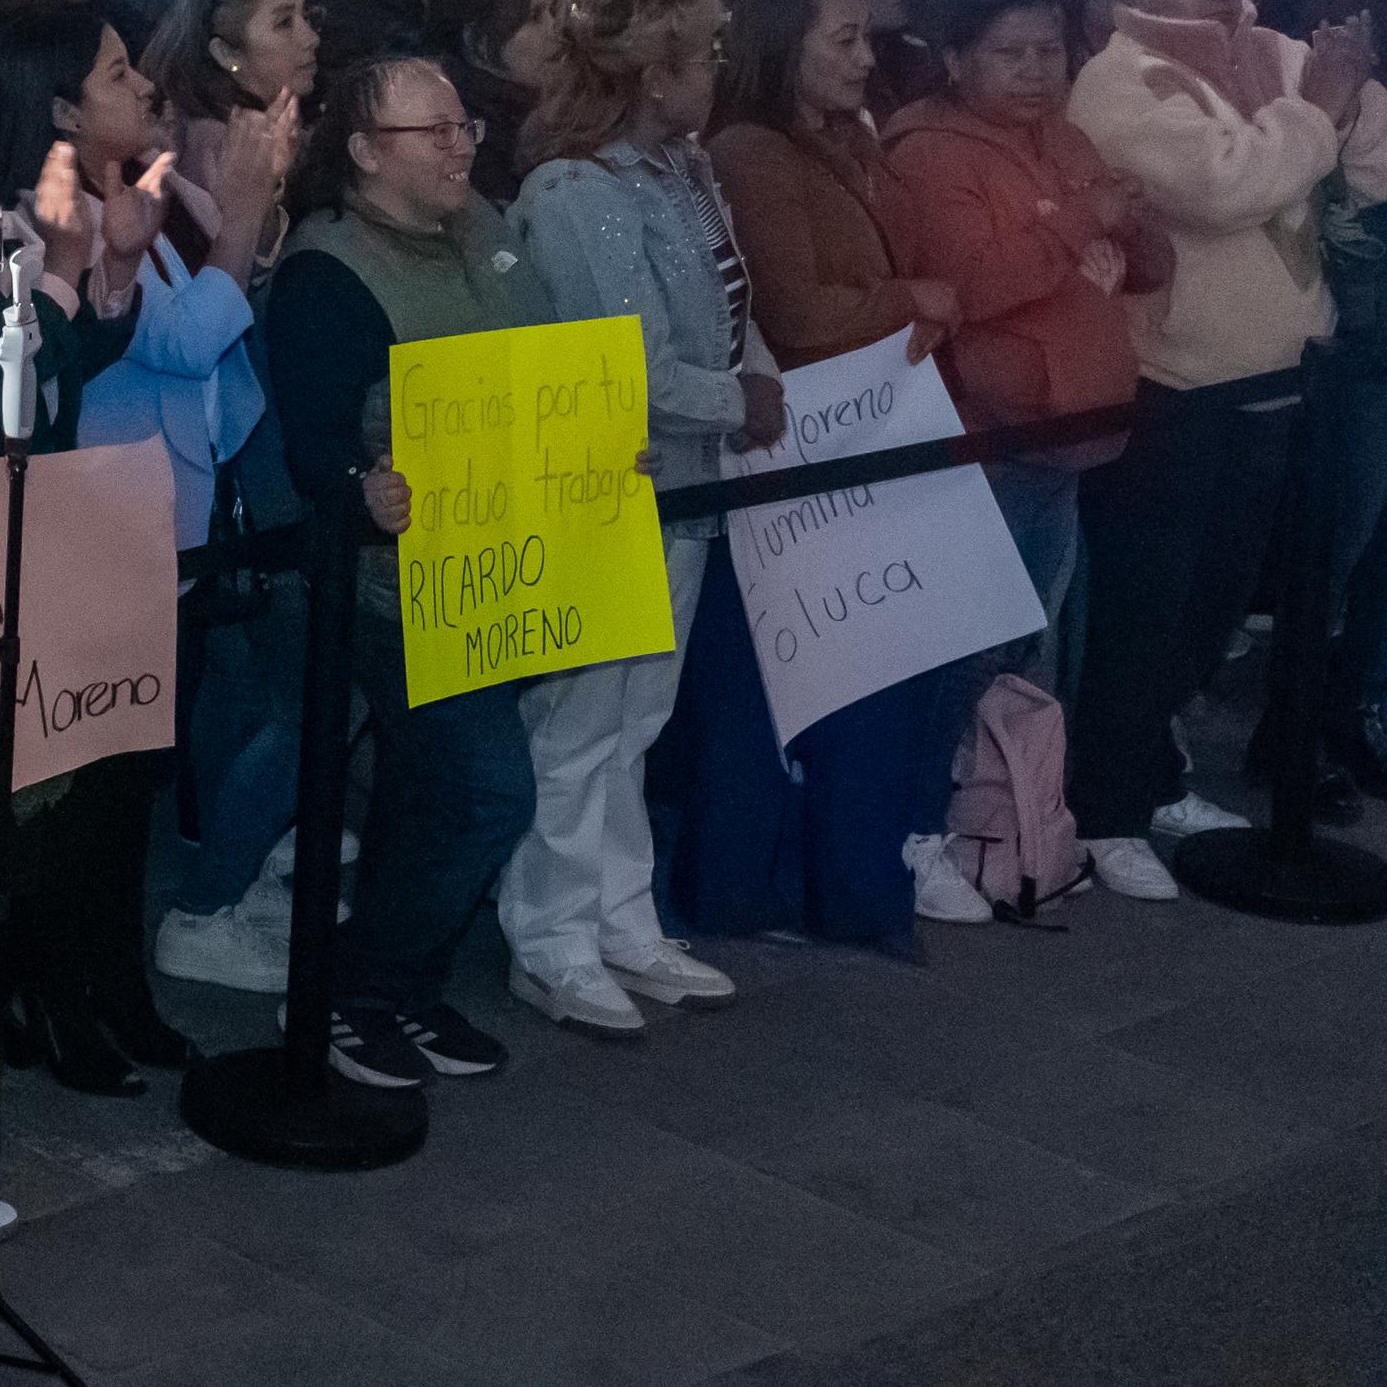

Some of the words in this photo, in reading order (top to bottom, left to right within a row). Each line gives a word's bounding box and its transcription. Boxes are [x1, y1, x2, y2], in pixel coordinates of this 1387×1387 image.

[401, 363, 515, 452] Gracias
[534, 378, 588, 452] por
[599, 354, 636, 421] tu
[420, 458, 508, 532] arduo
[534, 446, 641, 526] trabajo
[409, 534, 546, 631] RICARDO
[749, 560, 923, 663] oluca
[465, 605, 583, 678] MORENO
